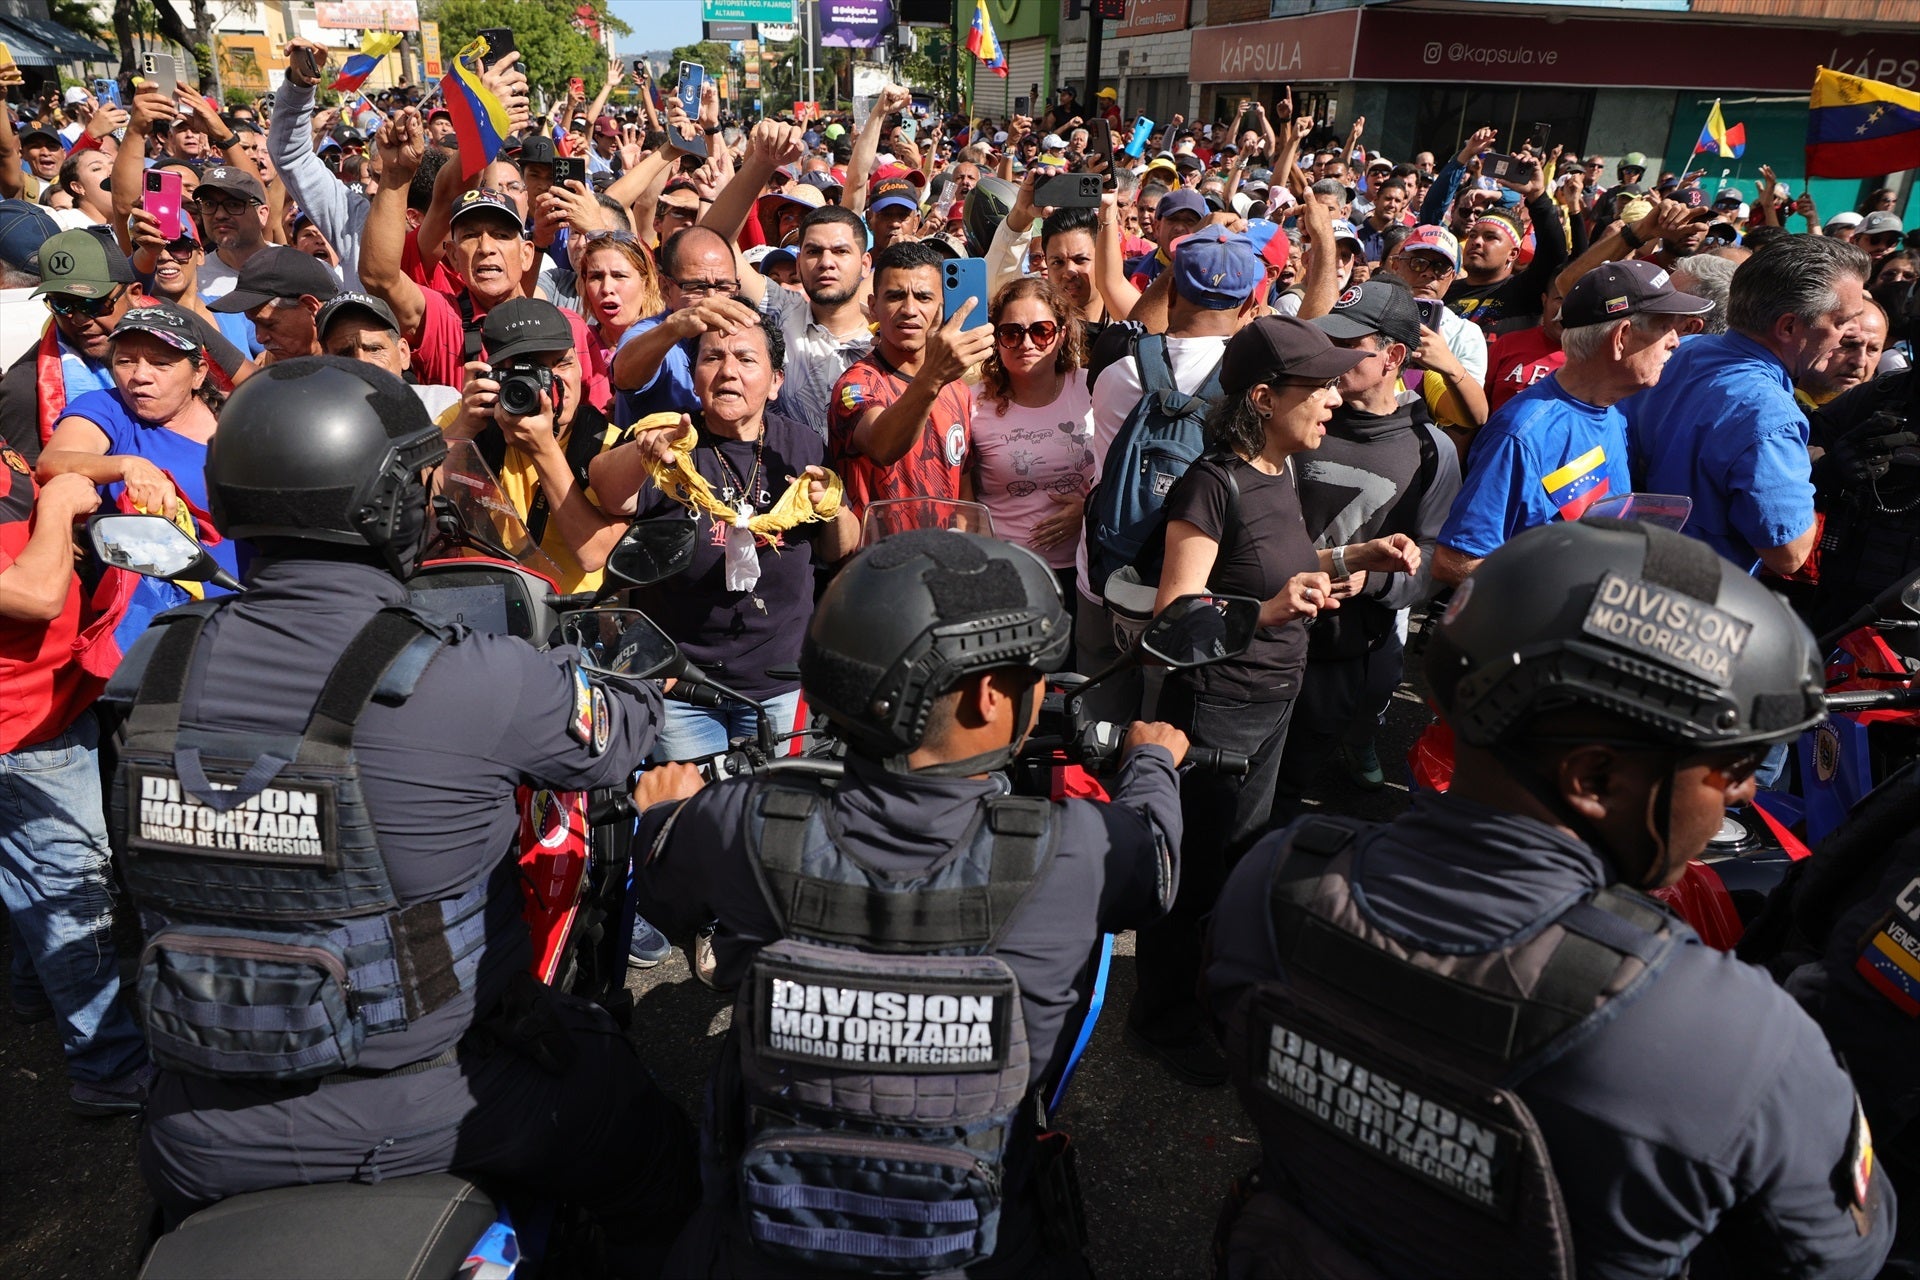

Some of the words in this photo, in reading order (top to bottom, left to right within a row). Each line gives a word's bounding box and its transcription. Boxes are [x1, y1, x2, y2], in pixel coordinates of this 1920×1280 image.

[1448, 42, 1559, 67] @kapsula.ve
[504, 319, 542, 332] YOUTH
[1592, 606, 1731, 678] MOTORIZADA
[140, 800, 320, 839] MOTORIZADA
[141, 823, 194, 845] UNIDAD
[195, 831, 215, 847] DE
[217, 832, 236, 849] LA
[239, 835, 322, 855] PRECISION
[772, 978, 993, 1023] DIVISION
[771, 1008, 992, 1047] MOTORIZADA
[770, 1033, 837, 1058] UNIDAD
[842, 1043, 865, 1061] DE
[868, 1045, 891, 1063] LA
[895, 1046, 993, 1064] PRECISION
[1270, 1024, 1497, 1159] DIVISION
[1268, 1050, 1492, 1188] MOTORIZADA
[1334, 1108, 1356, 1135] DE
[1359, 1124, 1382, 1150] LA
